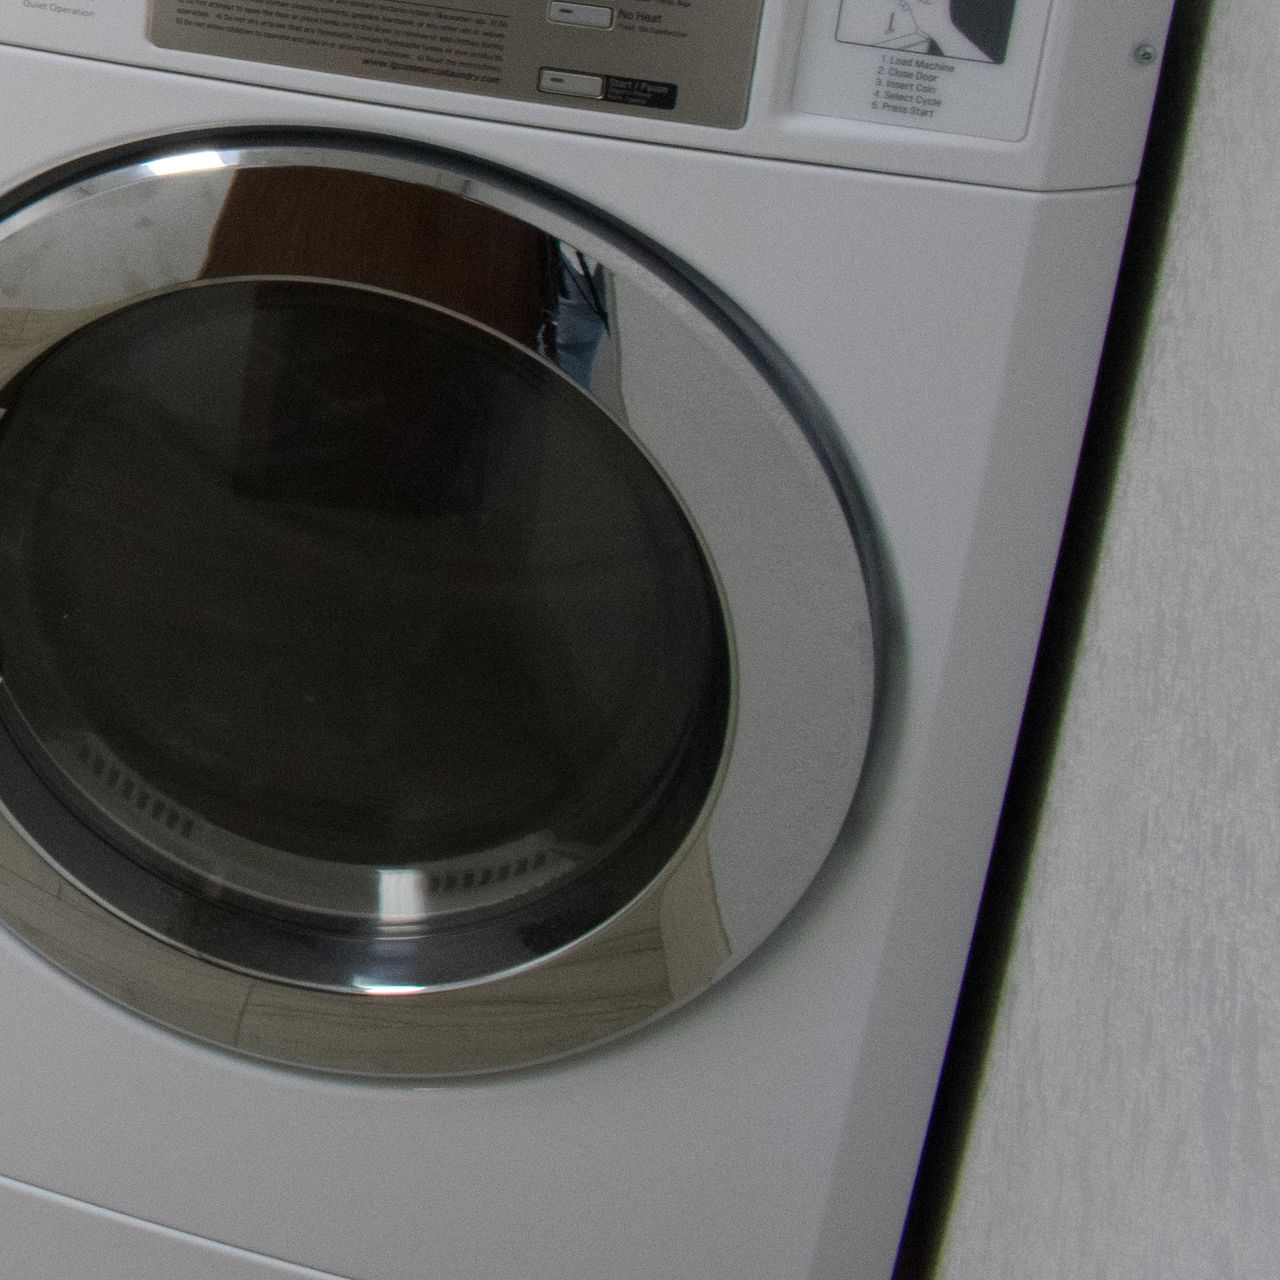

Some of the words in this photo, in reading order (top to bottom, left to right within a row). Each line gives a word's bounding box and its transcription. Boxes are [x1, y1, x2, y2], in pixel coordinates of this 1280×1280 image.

[23, 0, 48, 9] Quiet
[49, 3, 95, 17] Operation
[618, 9, 634, 20] No
[636, 11, 662, 23] Heat
[889, 56, 913, 67] Load
[915, 60, 955, 73] Machine
[888, 67, 914, 79] Close
[916, 71, 938, 82] Door
[886, 80, 914, 91] Insert
[916, 83, 936, 94] Coin
[884, 90, 914, 102] Select
[915, 95, 942, 107] Cycle
[882, 102, 908, 114] Press
[909, 106, 934, 118] Start
